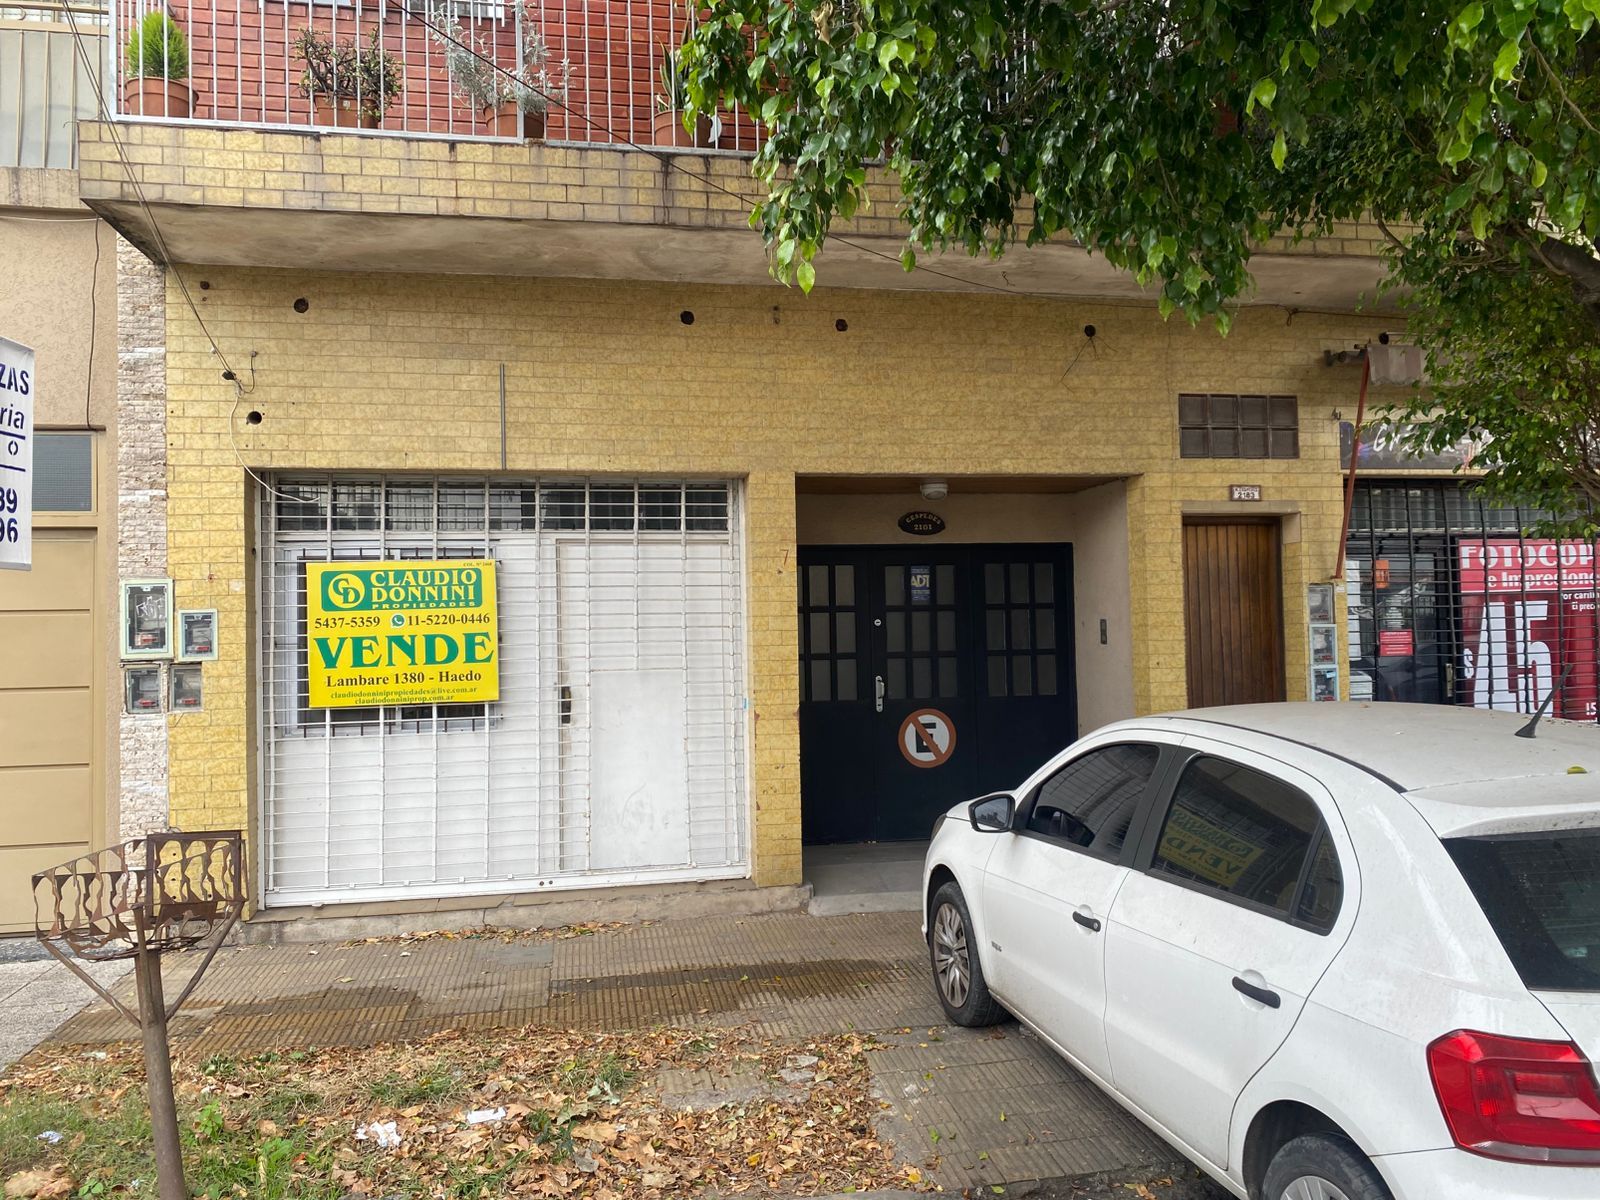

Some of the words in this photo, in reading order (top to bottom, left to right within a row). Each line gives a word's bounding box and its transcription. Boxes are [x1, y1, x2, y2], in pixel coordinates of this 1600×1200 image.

[370, 569, 476, 586] CLAUDIO
[910, 574, 931, 589] ADT
[371, 585, 476, 603] DONNINI
[372, 601, 476, 610] PROPIEDADES
[314, 616, 381, 629] 5437-5359
[408, 613, 490, 626] 11-5220-0446
[313, 631, 495, 670] VENDE
[326, 673, 390, 688] Lambare
[394, 672, 425, 684] 1380
[439, 670, 482, 683] Haedo
[330, 687, 478, 700] claudiodonninipropiedades@live.com.ar
[354, 694, 455, 704] claudiodonniniprop.com.ar
